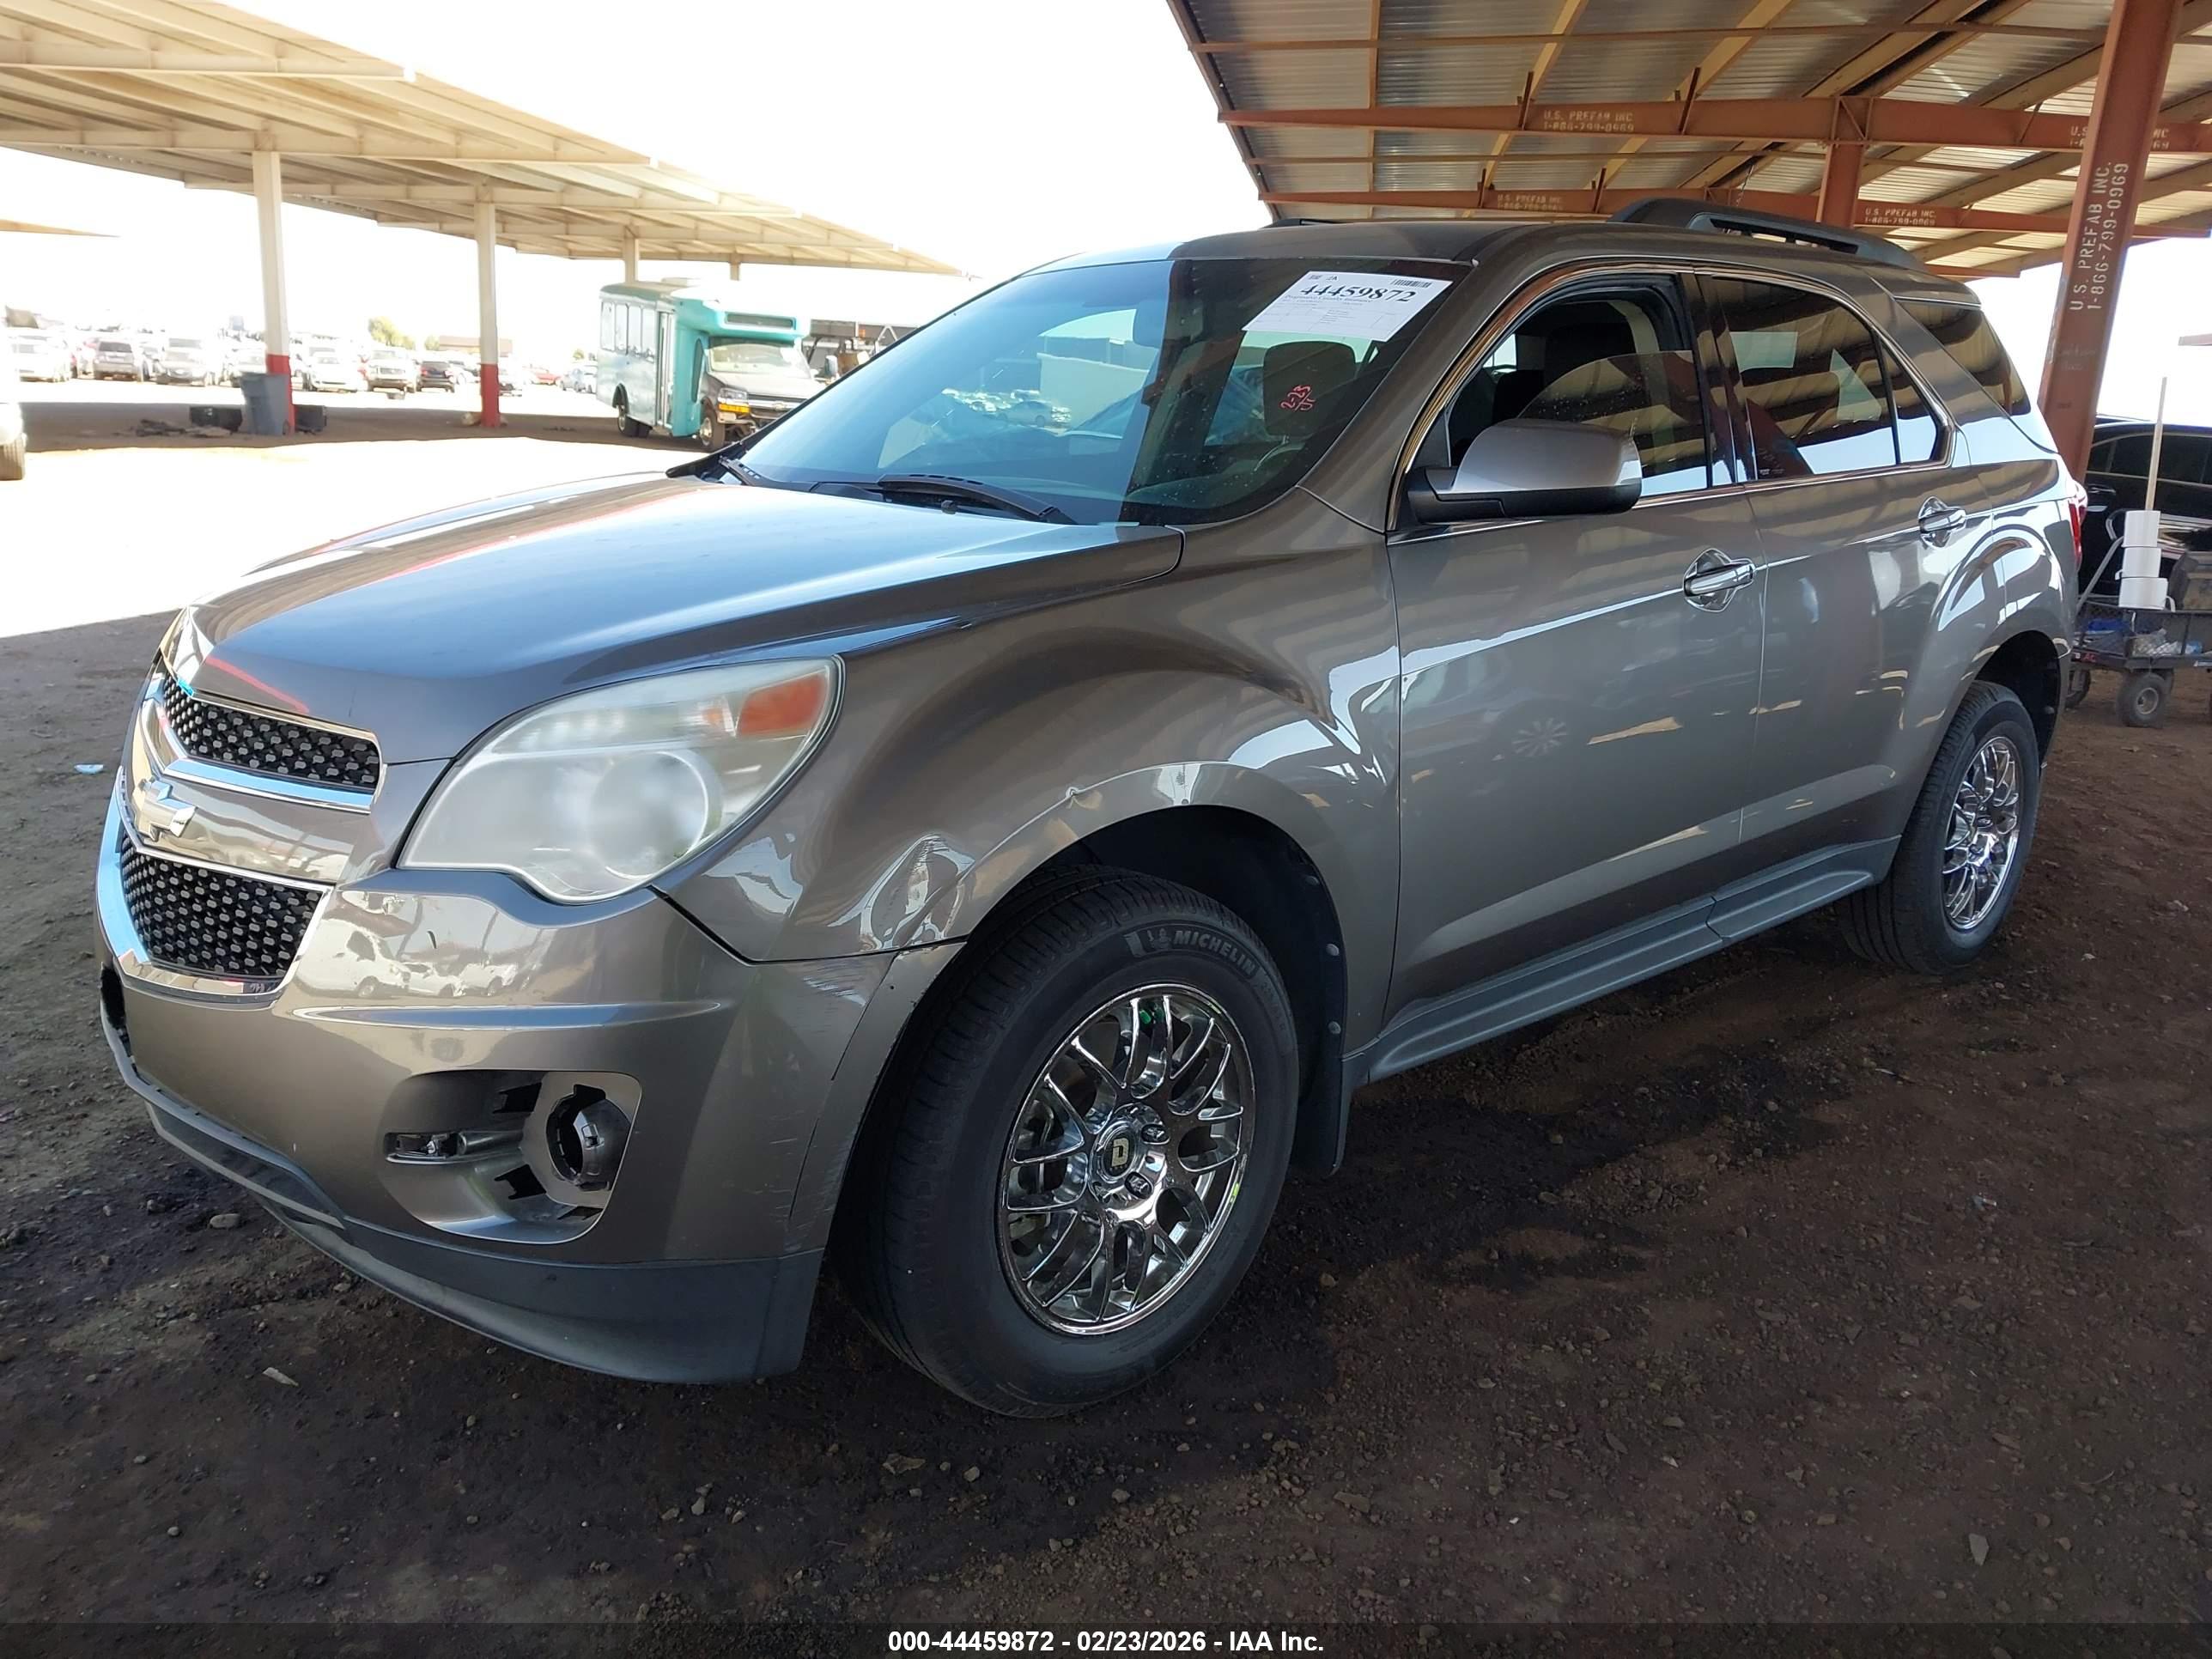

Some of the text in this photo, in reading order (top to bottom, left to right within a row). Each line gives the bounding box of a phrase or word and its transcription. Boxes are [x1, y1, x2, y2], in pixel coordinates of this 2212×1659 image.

[2069, 162, 2112, 310] U.S. PREFAB INC.
[2087, 163, 2129, 309] 1-866-799-0969
[1300, 284, 1416, 302] 44459872
[1173, 930, 1256, 975] MICHELIN
